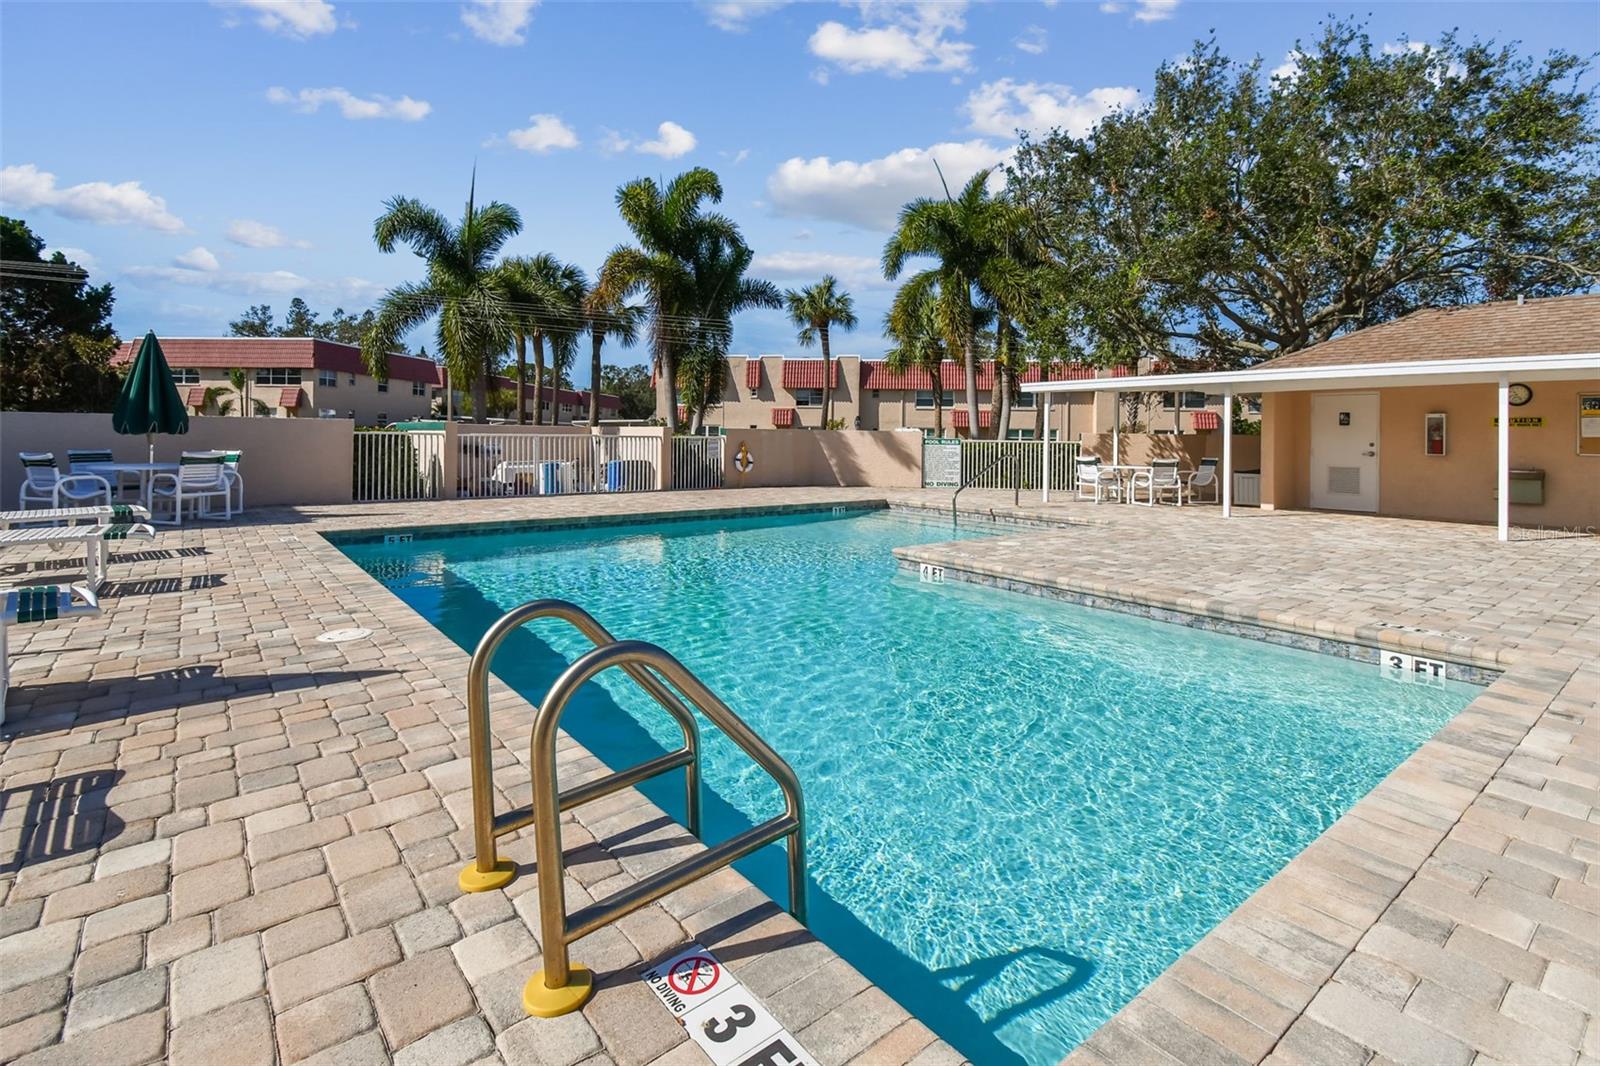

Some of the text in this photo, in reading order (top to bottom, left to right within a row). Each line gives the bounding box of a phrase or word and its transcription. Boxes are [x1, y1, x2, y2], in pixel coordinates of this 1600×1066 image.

[932, 567, 943, 577] FT
[1389, 656, 1444, 677] 3 FT
[646, 970, 686, 1013] NO DIVING
[703, 1004, 805, 1066] 3 F
